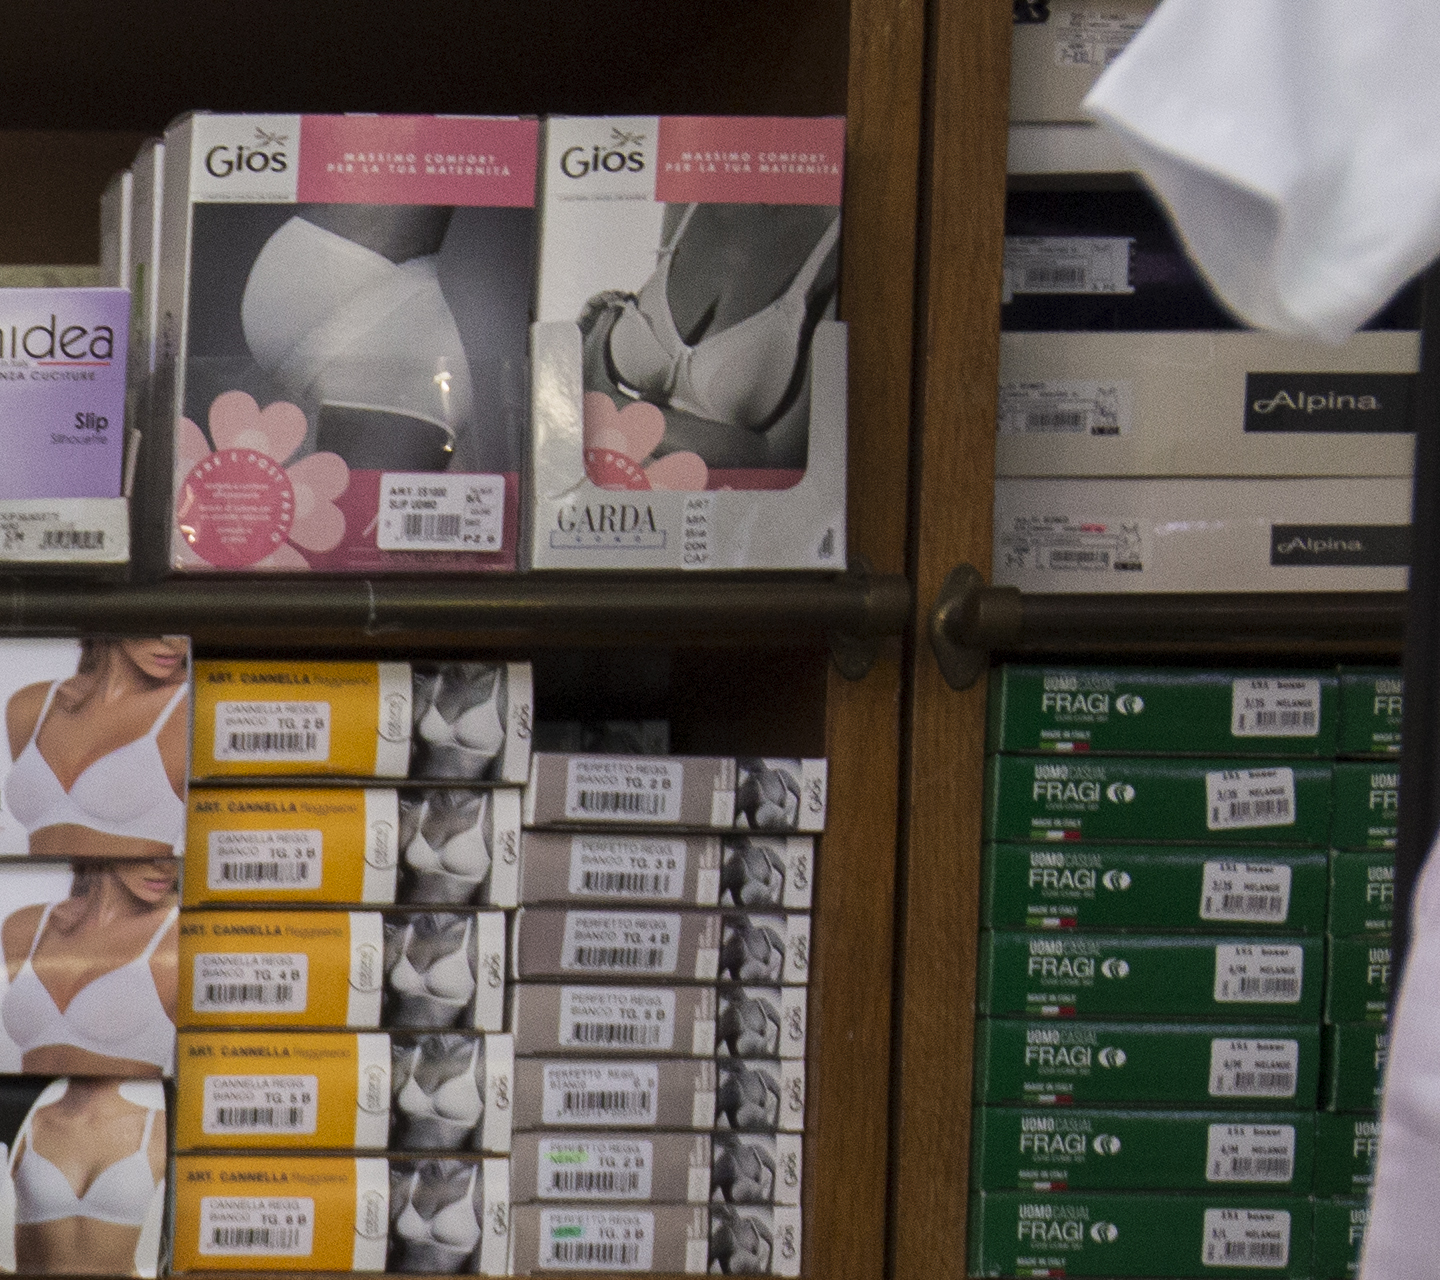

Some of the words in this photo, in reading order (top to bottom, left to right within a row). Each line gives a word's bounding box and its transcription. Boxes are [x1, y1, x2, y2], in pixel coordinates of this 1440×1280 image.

[206, 146, 287, 177] Gios
[344, 153, 416, 164] MASSIMO
[425, 154, 495, 165] COMFORT
[560, 146, 645, 178] Gios
[665, 162, 693, 174] PER
[681, 152, 751, 164] MASSIMO
[758, 153, 826, 164] COMFORT
[327, 163, 356, 174] PER
[30, 371, 96, 381] CUCITURE
[1254, 390, 1377, 414] Alpina
[75, 412, 109, 433] Slip
[557, 504, 658, 533] GARDA
[1277, 536, 1362, 554] Alpina
[240, 673, 311, 685] CANNELLA
[1042, 693, 1110, 714] FRAGI
[1033, 782, 1101, 802] FRAGI
[227, 801, 298, 813] CANNELLA
[1028, 869, 1097, 889] FRAGI
[213, 925, 282, 936] CANNELLA
[1028, 956, 1096, 977] FRAGI
[221, 1046, 291, 1058] CANNELLA
[1025, 1046, 1092, 1067] FRAGI
[1020, 1133, 1087, 1153] FRAGI
[220, 1171, 290, 1183] CANNELLA
[1017, 1221, 1085, 1241] FRAGI
